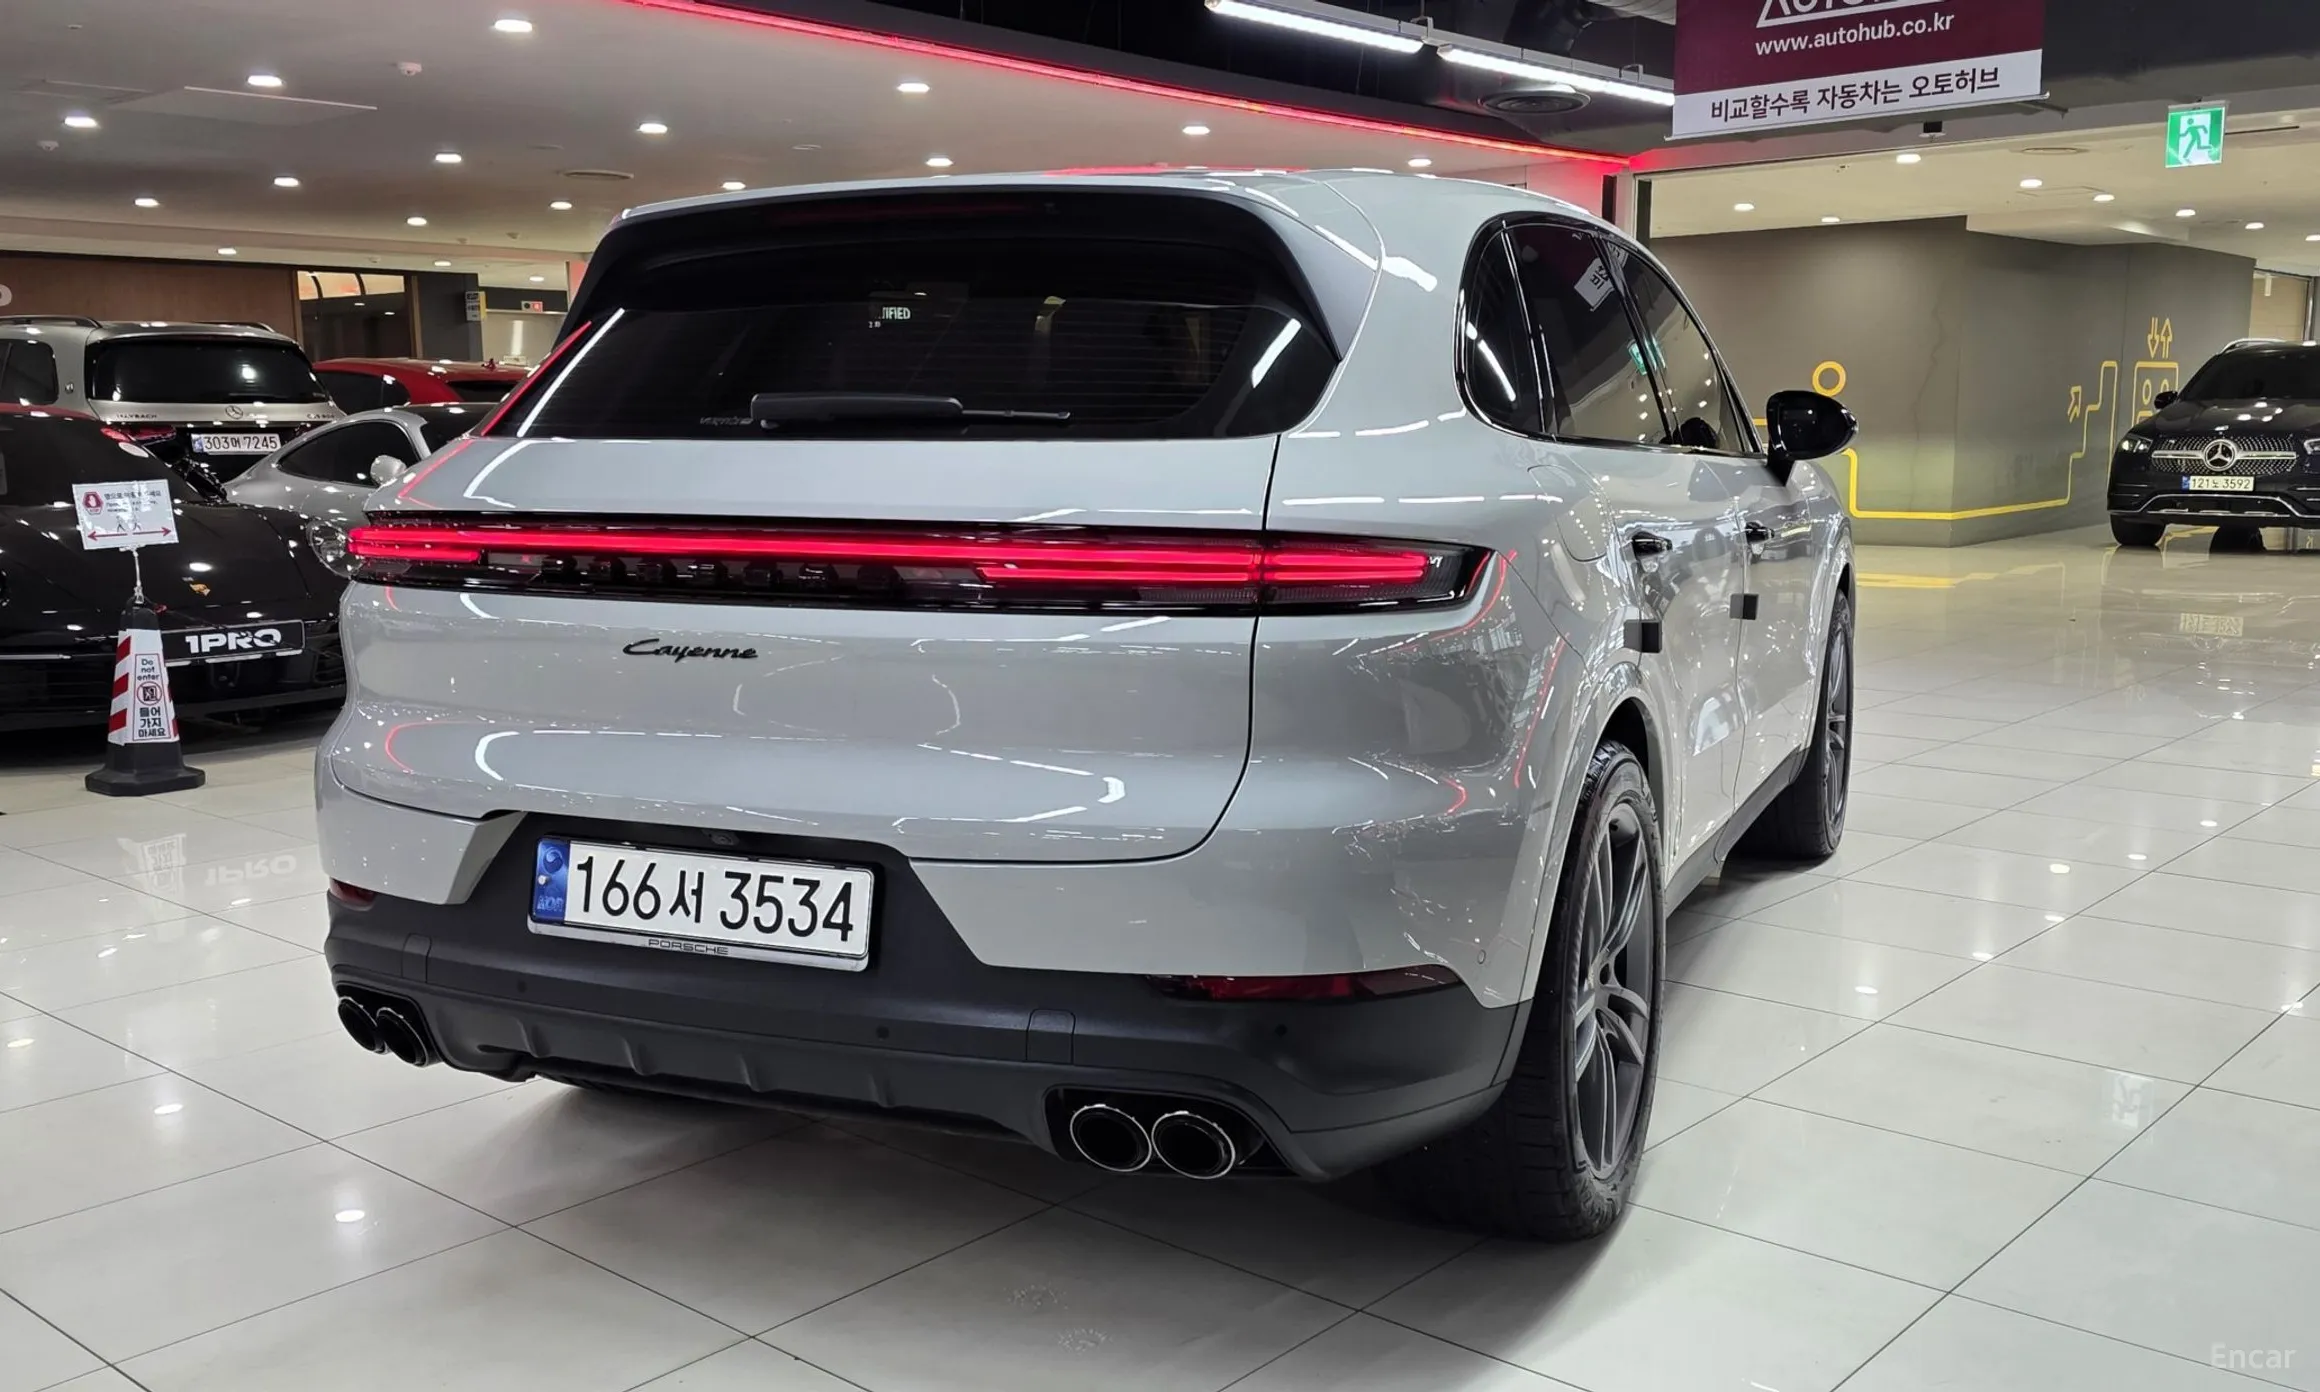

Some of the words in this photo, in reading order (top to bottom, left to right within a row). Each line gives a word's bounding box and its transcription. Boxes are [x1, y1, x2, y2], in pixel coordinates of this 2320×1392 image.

[1755, 12, 1955, 56] www.autohub.co.kr
[1710, 89, 1811, 123] 비교할수록
[1816, 78, 1903, 110] 자동차는
[1908, 67, 2001, 100] 오토허브
[243, 436, 278, 450] 7245
[2222, 478, 2251, 489] 3592
[622, 638, 758, 663] Cayenne
[140, 718, 162, 729] 가지
[138, 728, 166, 738] 마세요
[576, 855, 705, 924] 166서
[719, 871, 854, 942] 3534
[648, 938, 729, 955] PORSCHE
